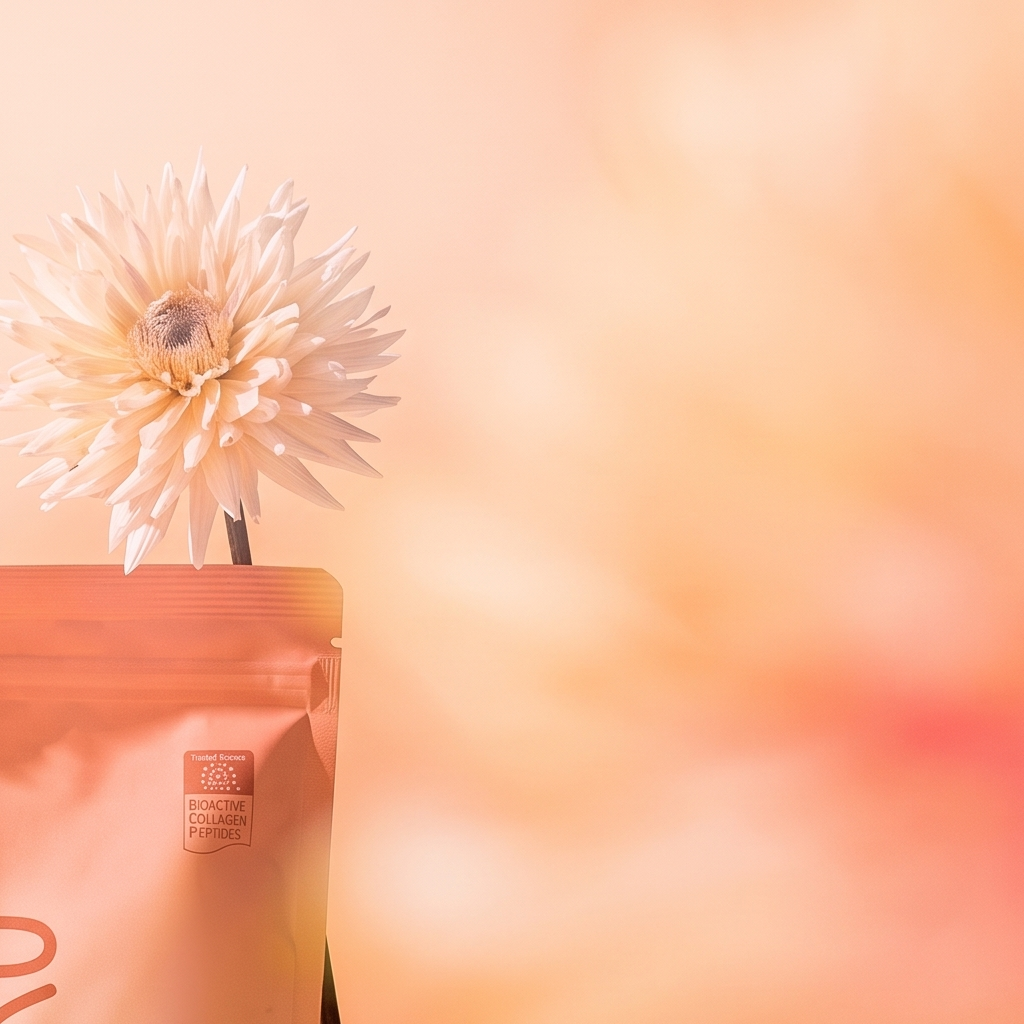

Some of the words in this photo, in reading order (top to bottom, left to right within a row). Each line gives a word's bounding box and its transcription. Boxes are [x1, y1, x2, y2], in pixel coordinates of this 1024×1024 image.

[189, 799, 246, 812] BIOACTIVE
[189, 812, 247, 826] COLLAGEN
[189, 826, 241, 840] PEPTIDES
